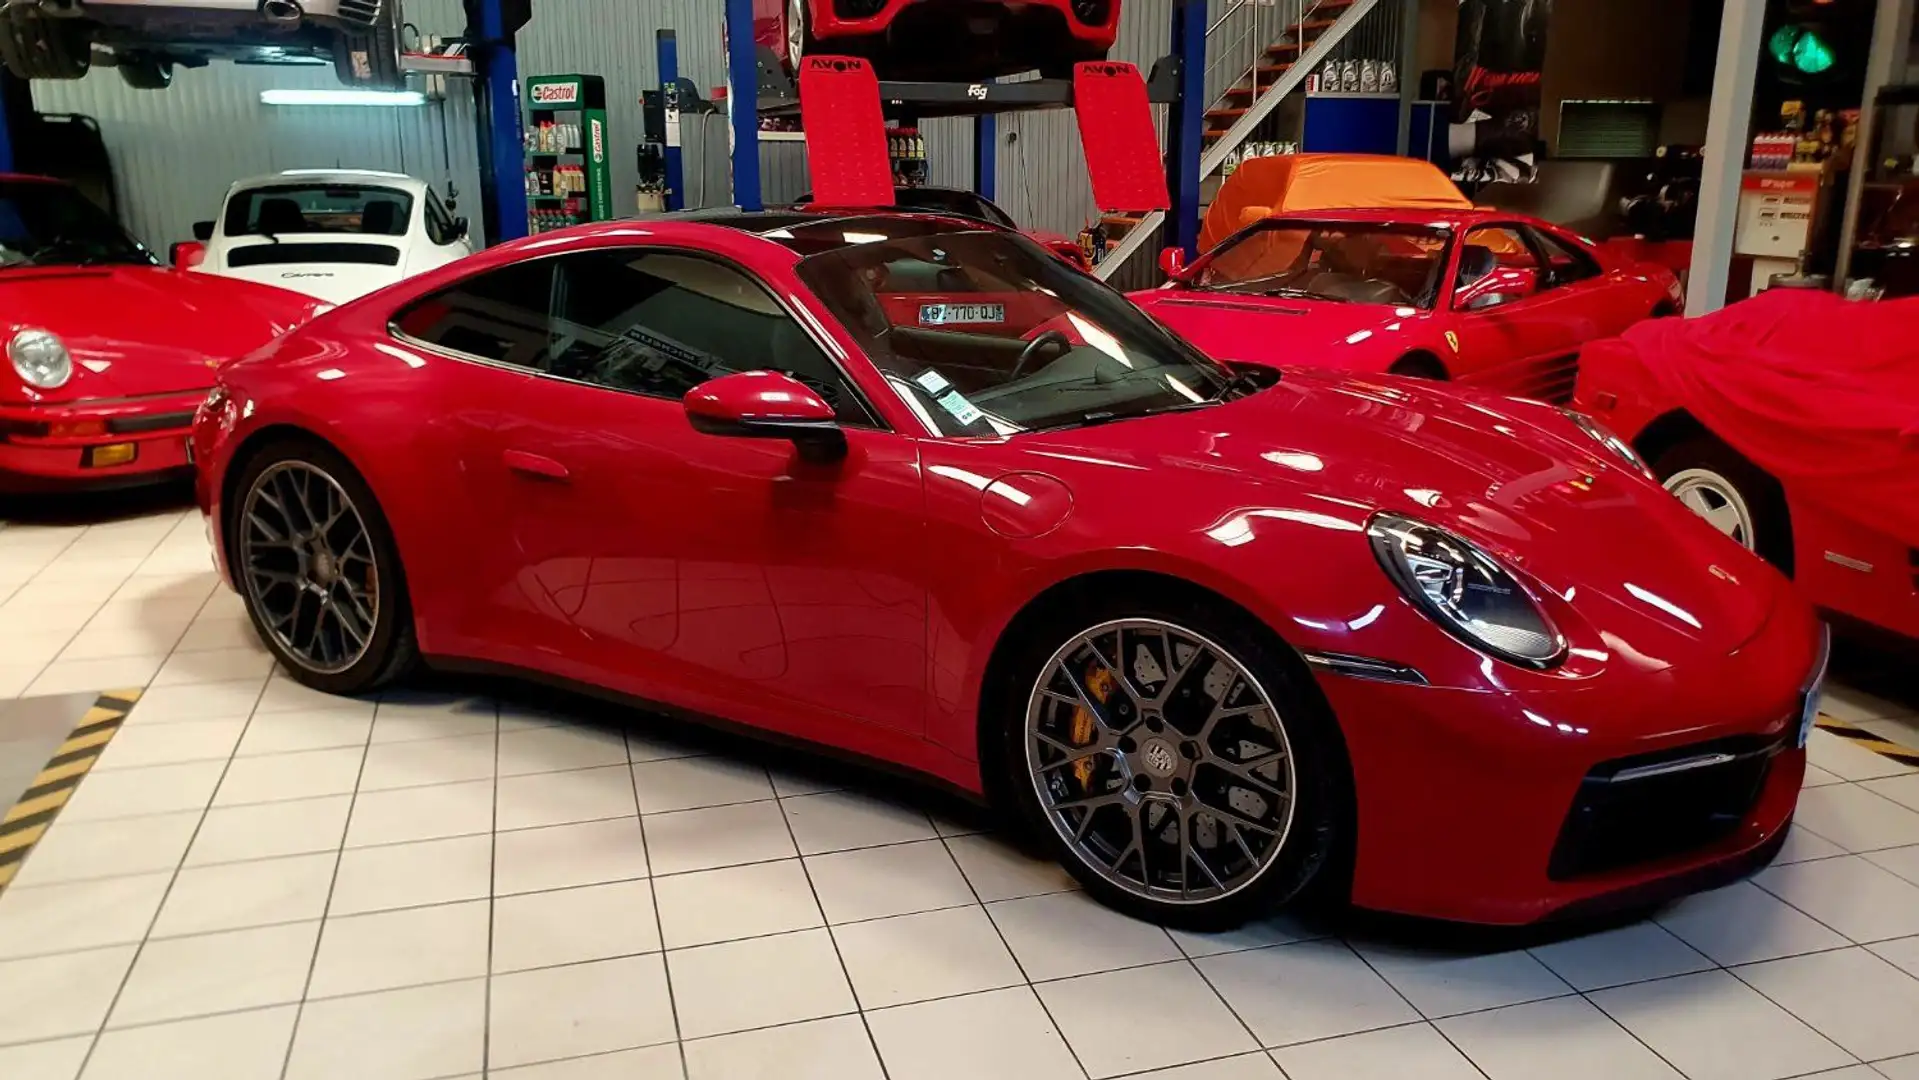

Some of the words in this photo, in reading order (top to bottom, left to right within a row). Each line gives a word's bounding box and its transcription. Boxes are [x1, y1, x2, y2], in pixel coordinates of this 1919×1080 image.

[811, 59, 861, 72] AVON
[1083, 65, 1130, 77] AVON
[542, 85, 574, 100] Castrol
[594, 123, 602, 154] Castrol
